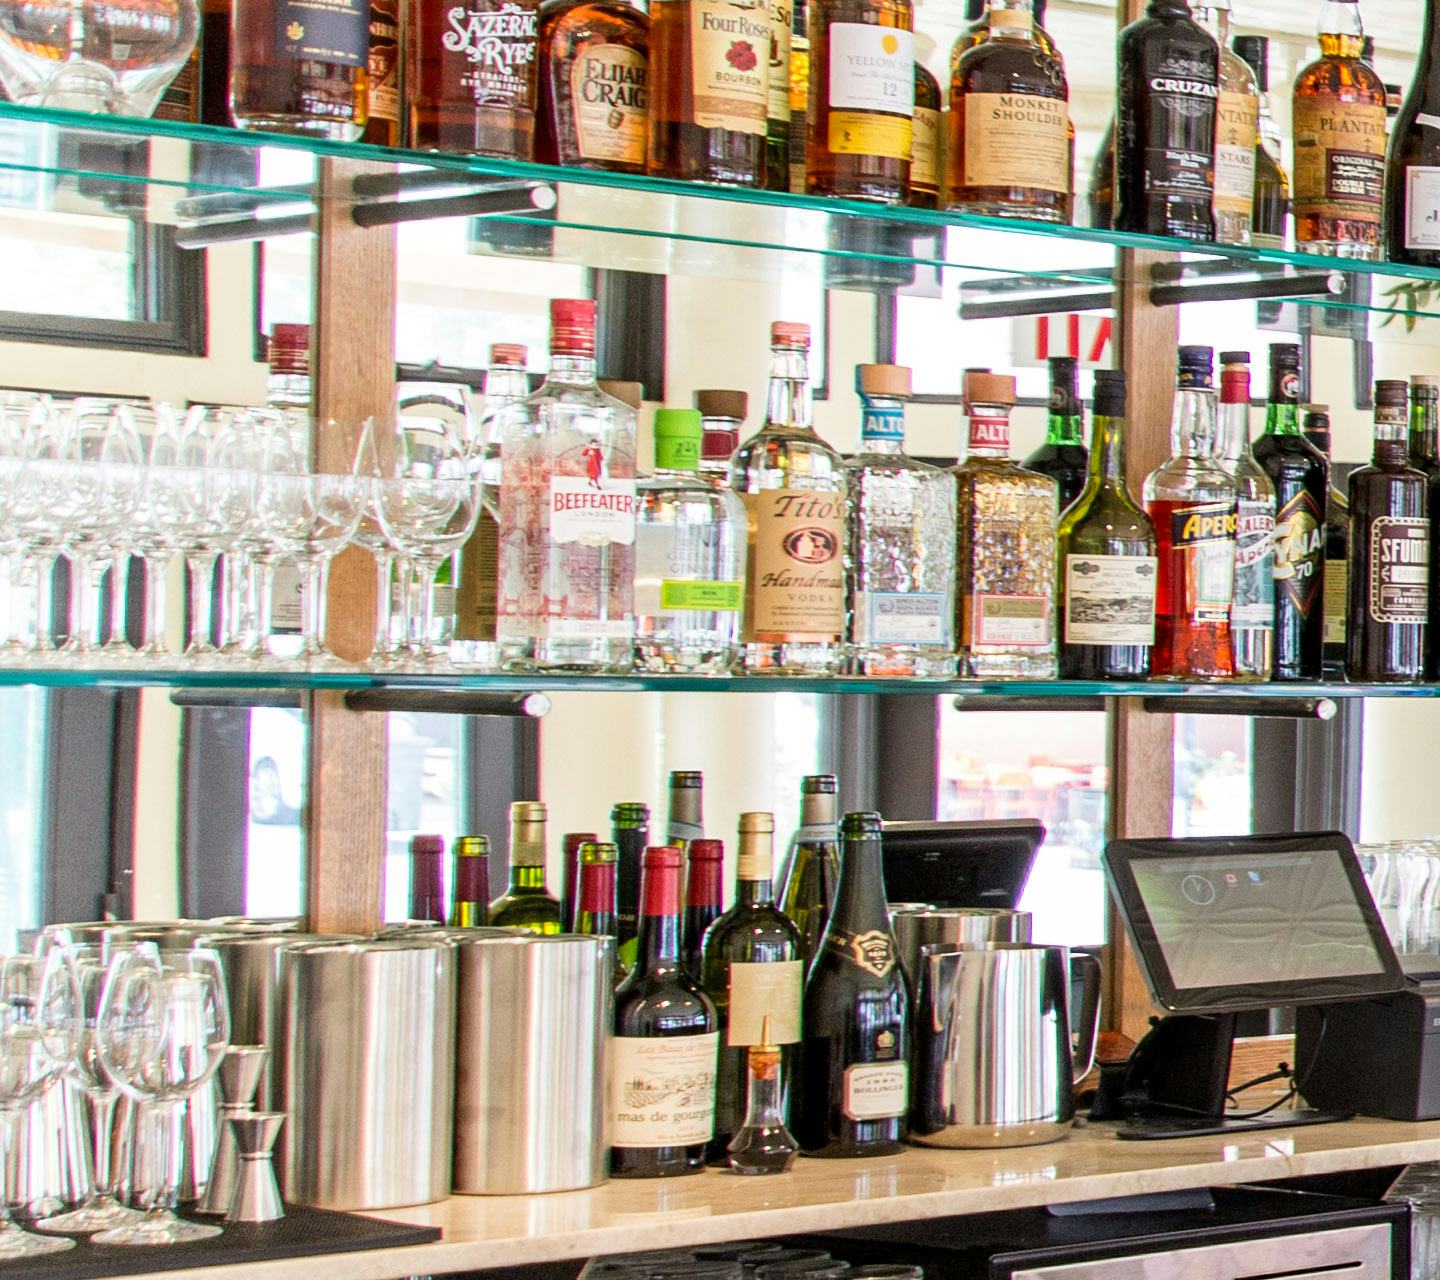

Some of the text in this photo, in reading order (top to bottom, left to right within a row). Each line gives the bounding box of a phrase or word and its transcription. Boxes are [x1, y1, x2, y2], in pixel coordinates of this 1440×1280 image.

[702, 11, 738, 33] Four
[846, 55, 896, 69] YELLOW
[584, 58, 645, 86] ELIJAH
[715, 71, 762, 86] BOURBON
[582, 79, 645, 108] CRAIG
[882, 81, 898, 97] 12
[1150, 78, 1219, 97] CRUZAN
[999, 95, 1061, 113] MONKEY
[554, 492, 636, 516] BEEFEATER
[773, 492, 845, 519] Tito's
[1296, 561, 1313, 579] 70
[787, 593, 834, 603] VODKA
[618, 1112, 646, 1122] mas
[650, 1111, 668, 1122] de
